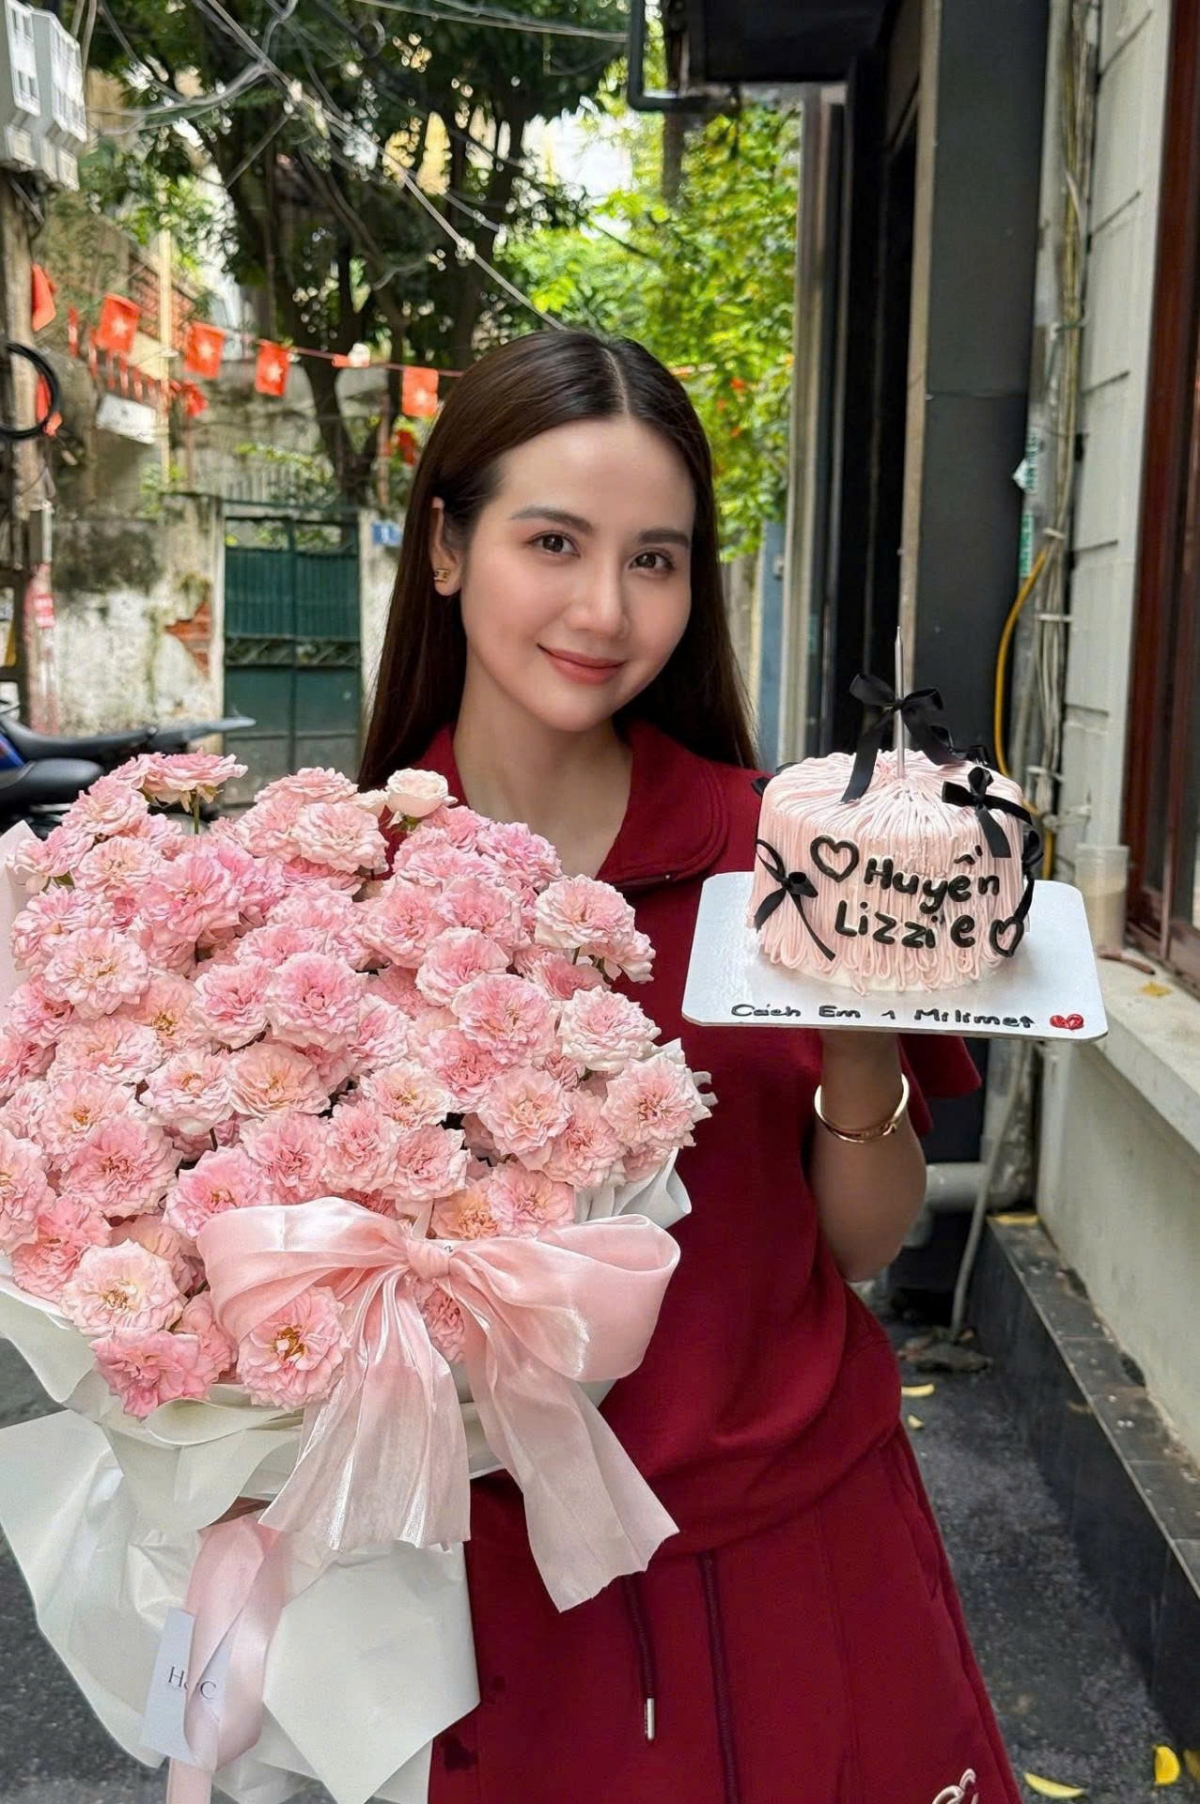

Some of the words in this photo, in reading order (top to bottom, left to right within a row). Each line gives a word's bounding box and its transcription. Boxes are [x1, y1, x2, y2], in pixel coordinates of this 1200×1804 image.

[835, 900, 976, 949] Lizzie
[731, 1003, 802, 1018] Cách
[818, 1005, 861, 1019] Em
